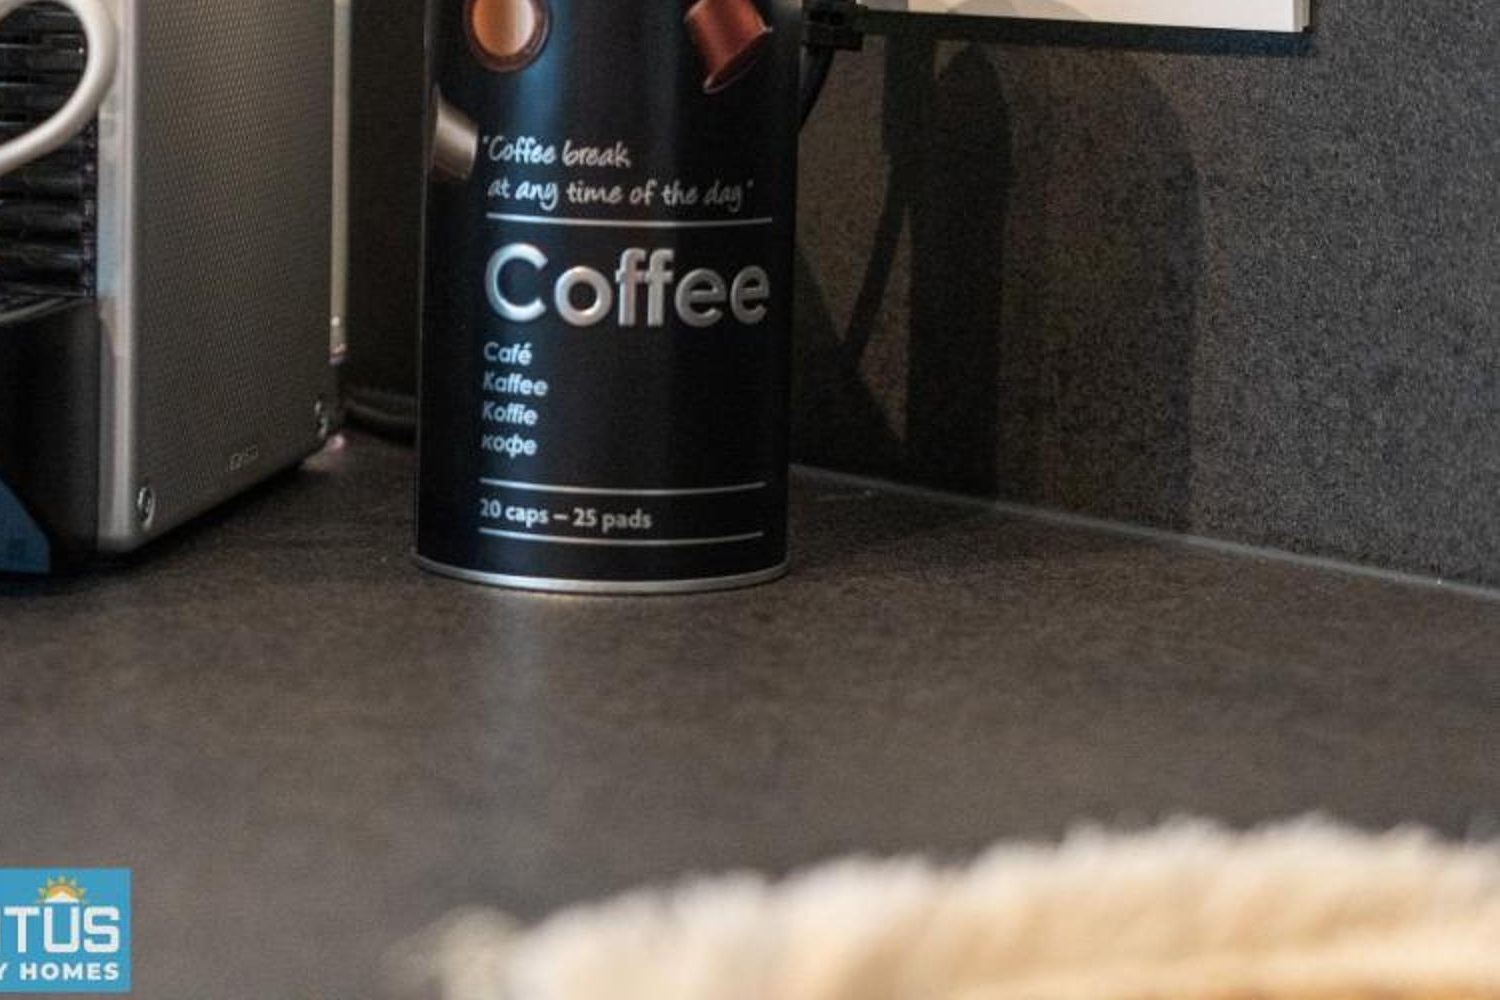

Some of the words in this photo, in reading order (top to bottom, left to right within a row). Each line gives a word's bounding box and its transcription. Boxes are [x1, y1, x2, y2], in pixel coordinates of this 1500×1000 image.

[562, 140, 631, 168] break
[487, 176, 511, 199] at
[515, 180, 558, 212] any
[566, 180, 624, 205] time
[630, 179, 657, 206] of
[661, 180, 699, 207] the
[484, 241, 771, 328] Coffee
[483, 340, 533, 366] Café
[482, 372, 549, 397] Kaffee
[481, 402, 539, 425] Koffie
[479, 498, 502, 519] 20
[505, 502, 549, 528] caps
[572, 507, 597, 527] 25
[601, 508, 653, 533] pads
